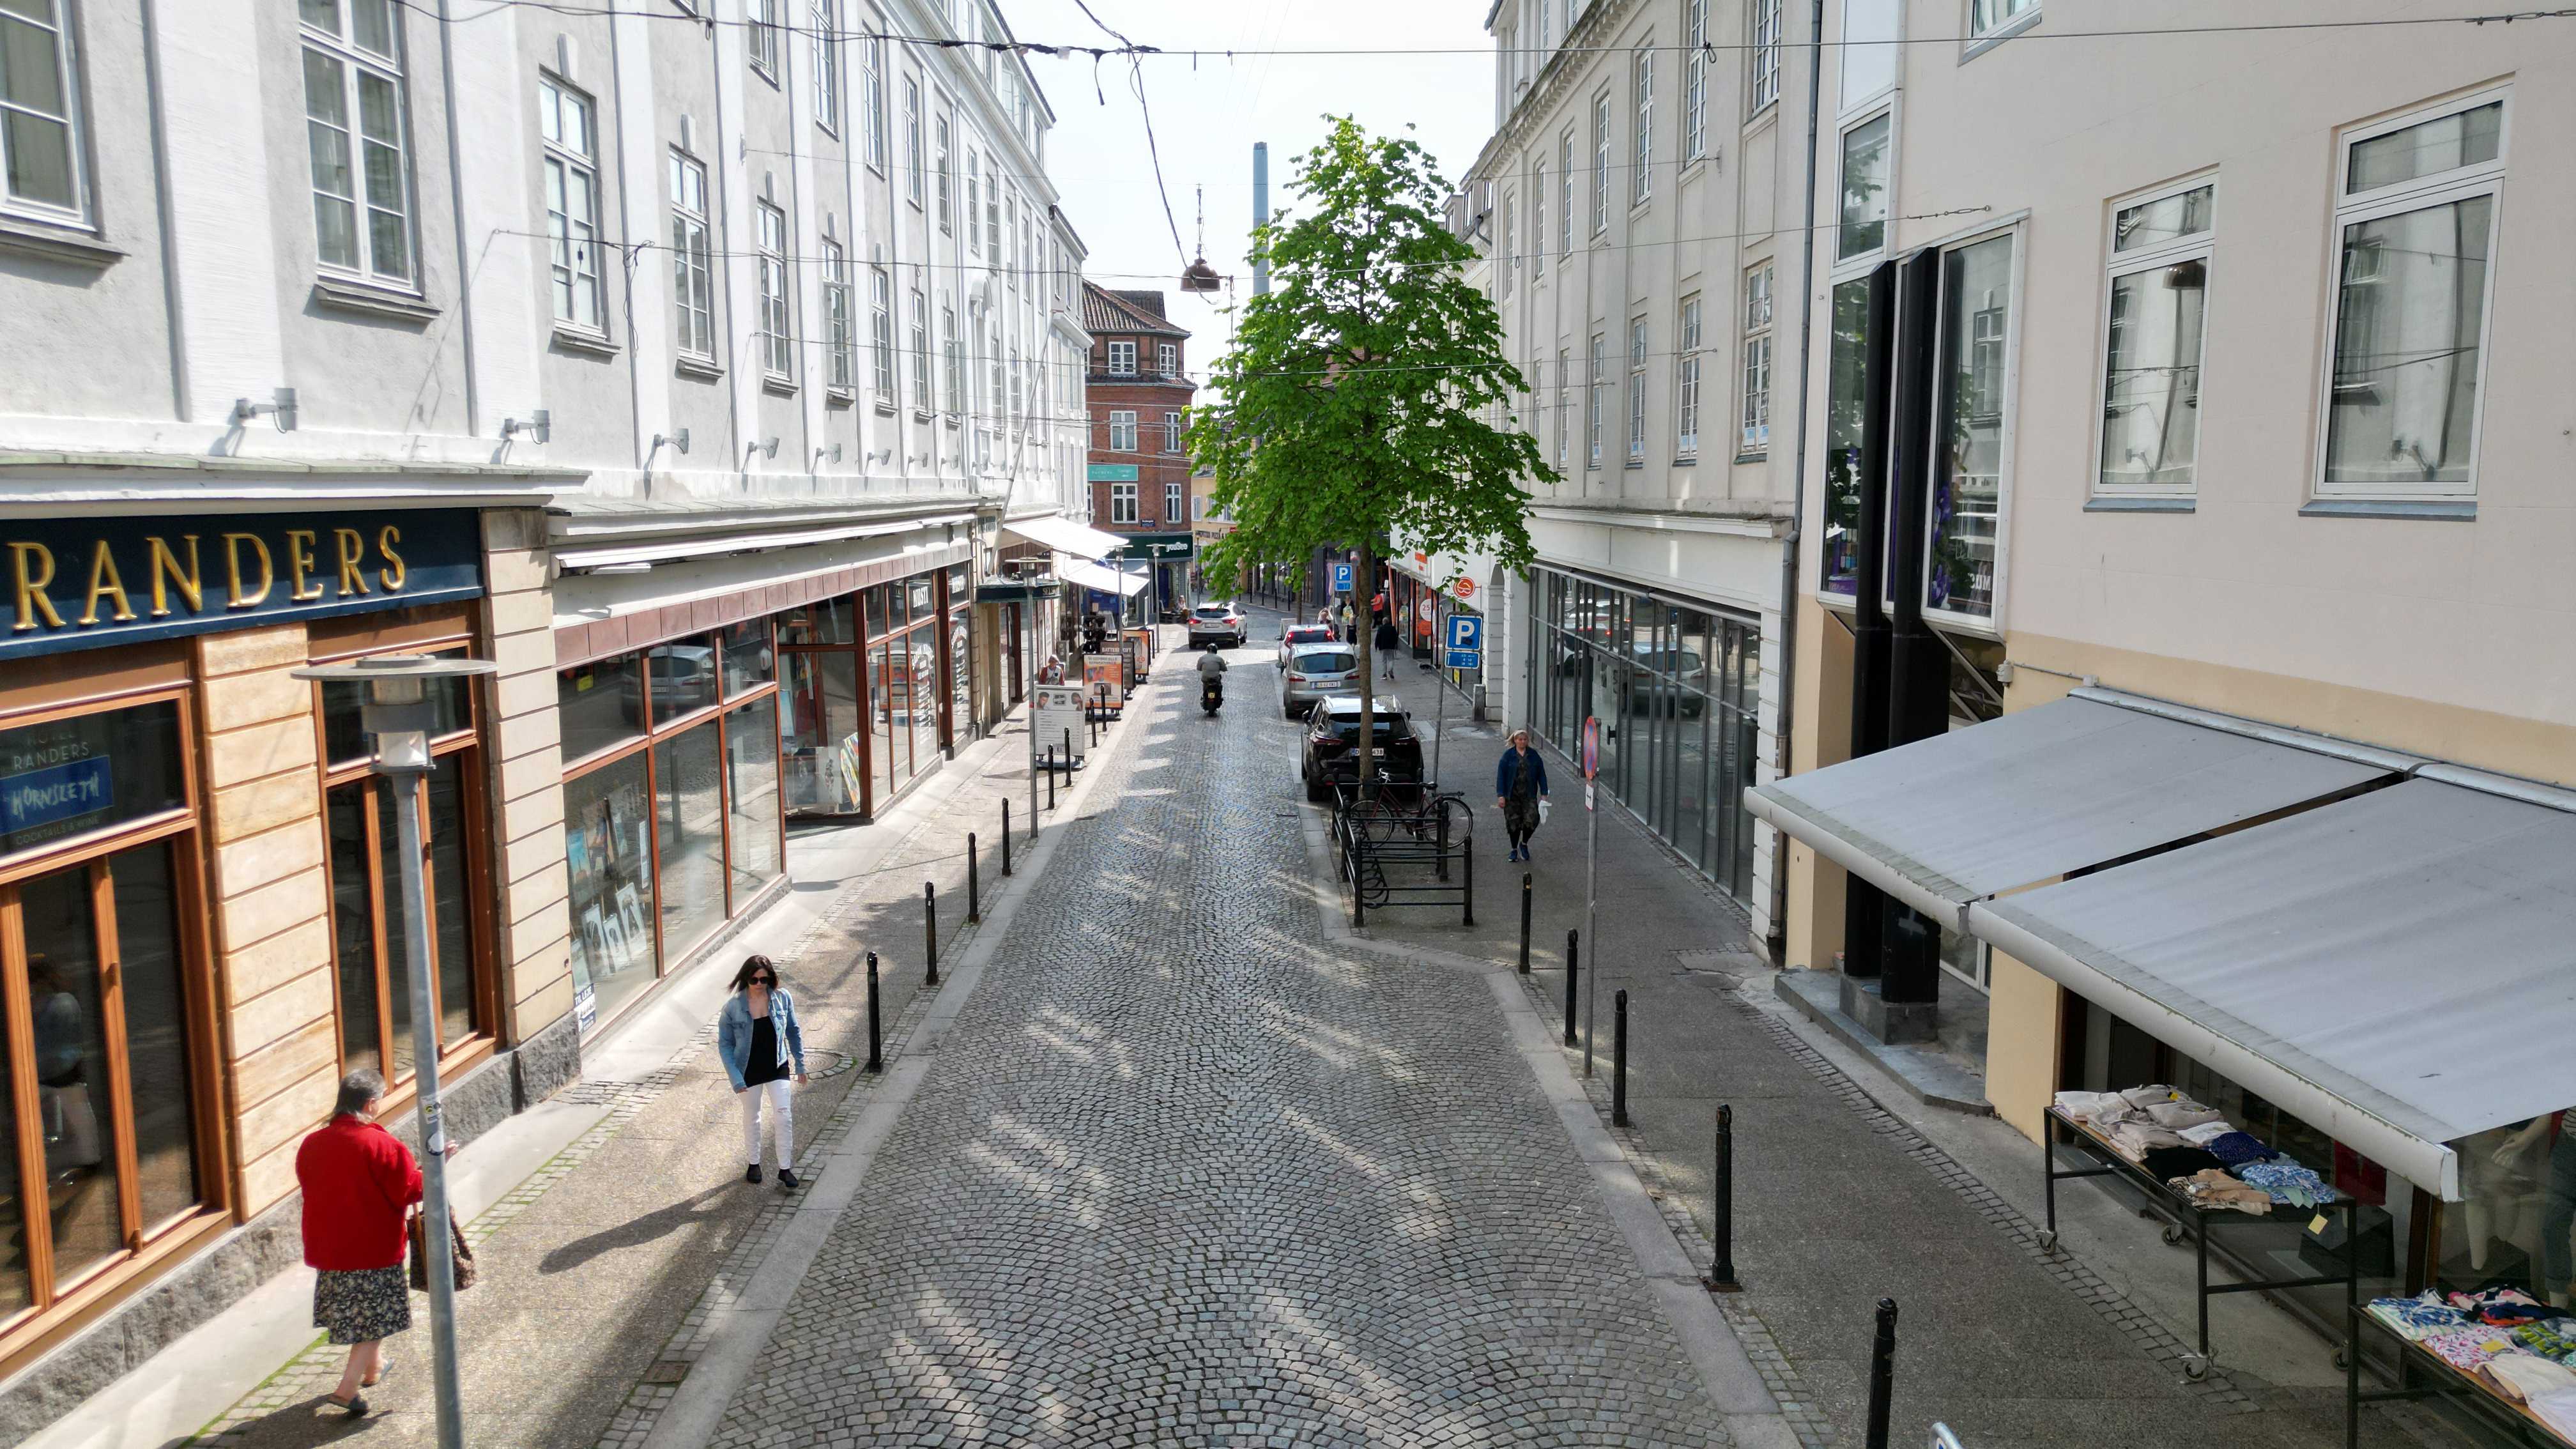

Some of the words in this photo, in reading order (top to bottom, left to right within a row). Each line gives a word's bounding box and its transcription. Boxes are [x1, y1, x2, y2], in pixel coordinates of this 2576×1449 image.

[7, 525, 405, 631] RANDERS
[1339, 567, 1348, 579] P
[913, 586, 928, 608] MUSTI
[1455, 620, 1475, 645] P
[13, 742, 90, 770] RANDERS
